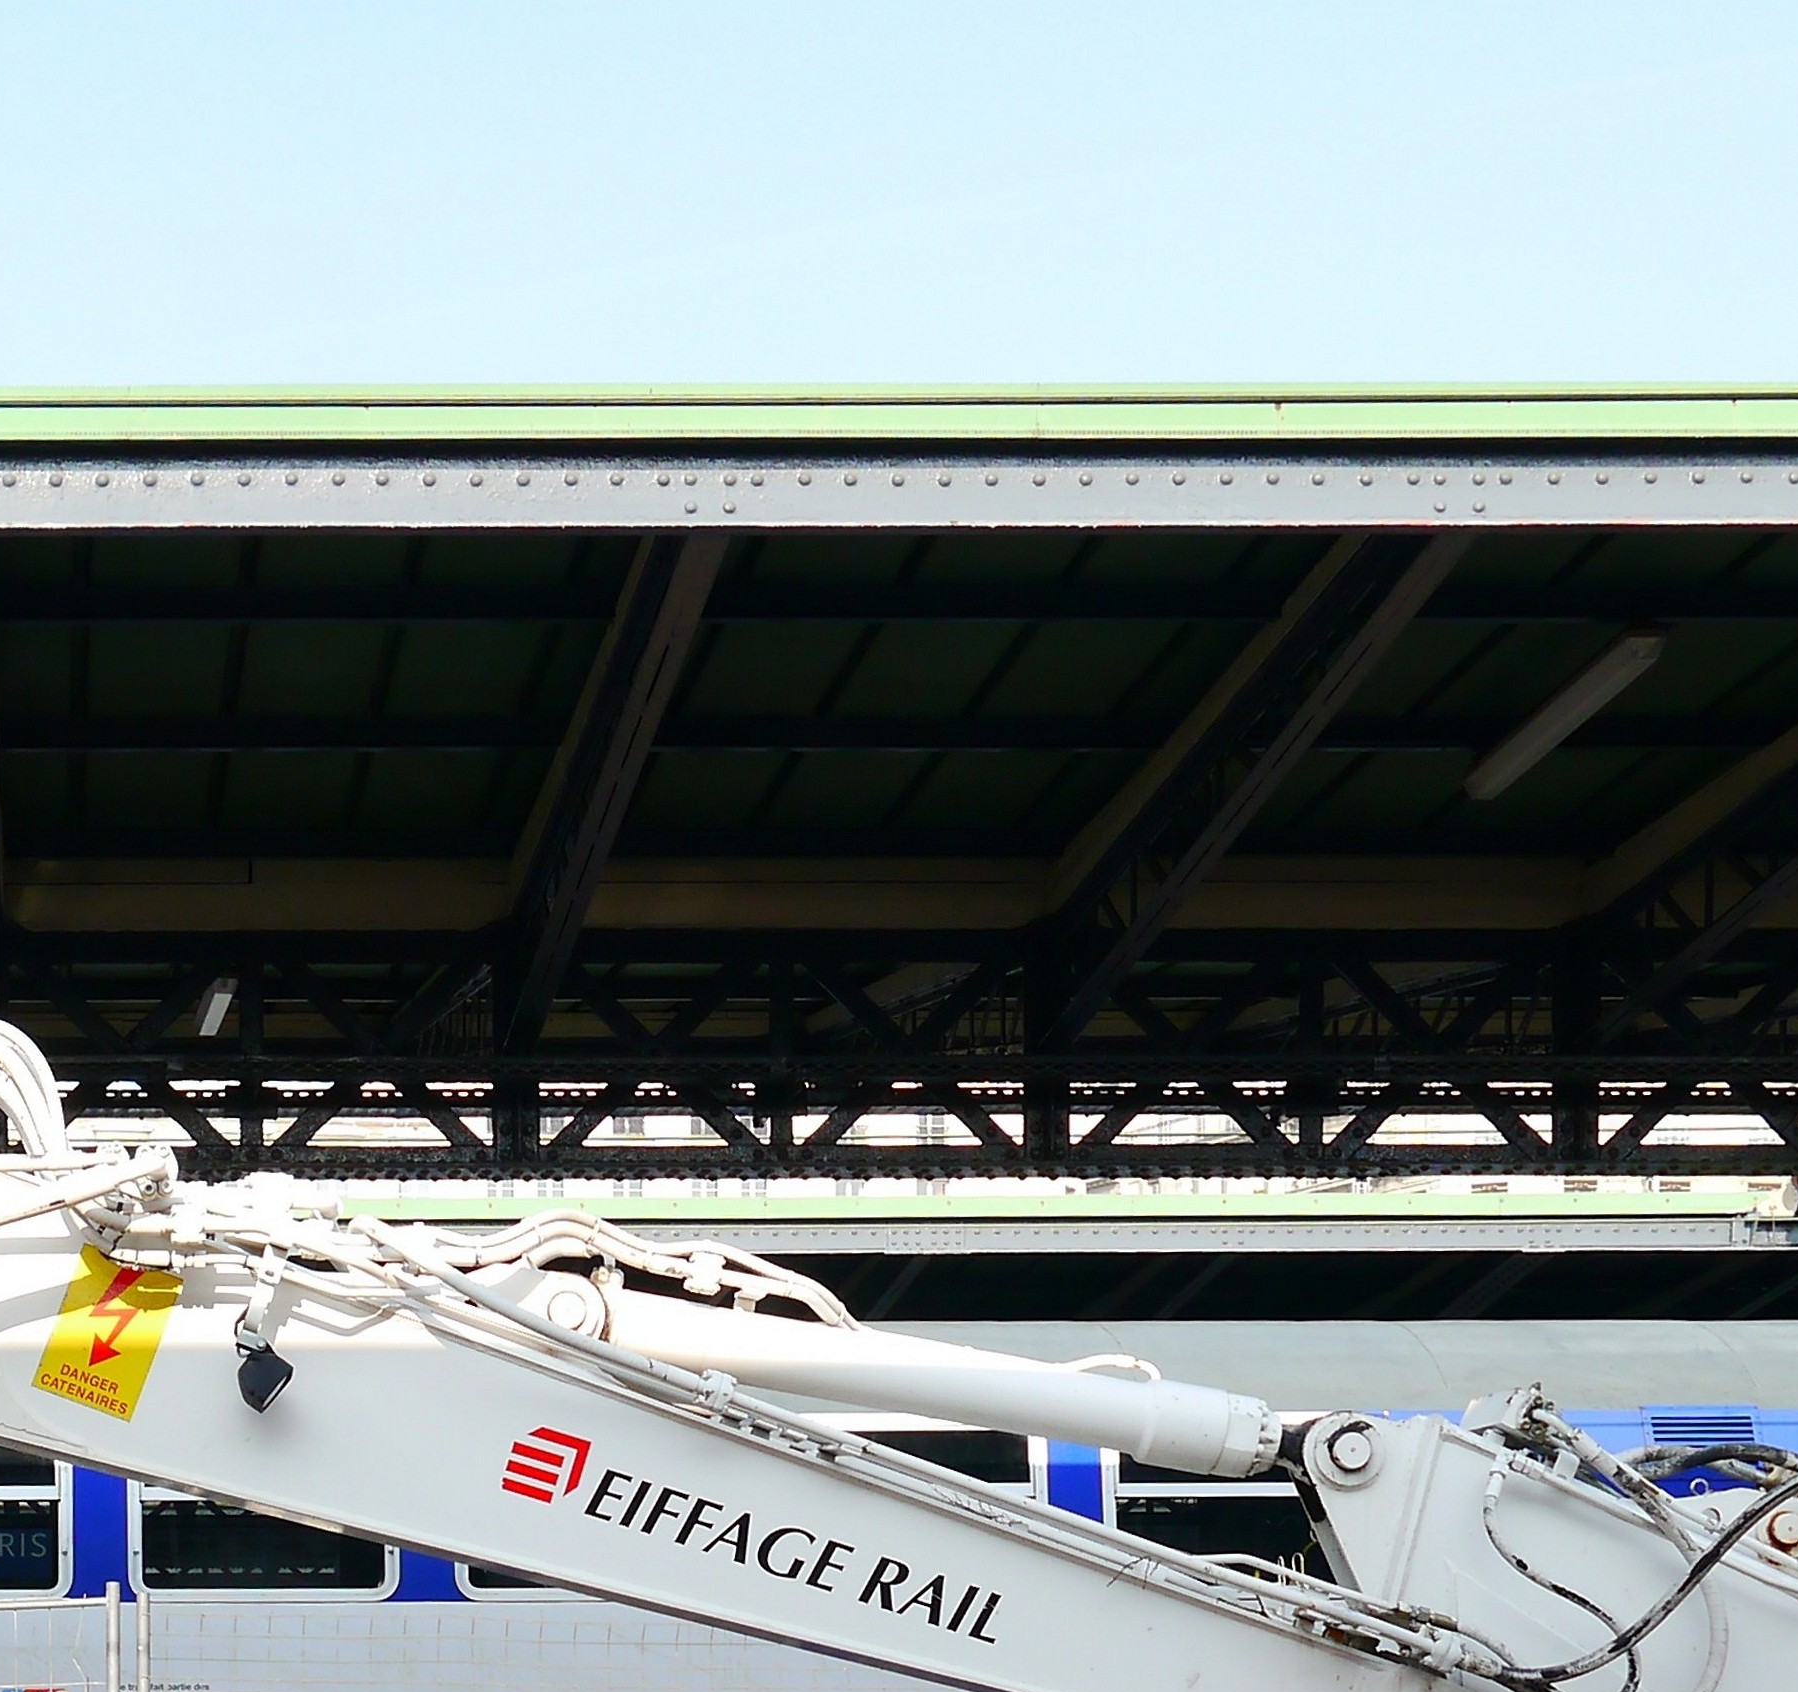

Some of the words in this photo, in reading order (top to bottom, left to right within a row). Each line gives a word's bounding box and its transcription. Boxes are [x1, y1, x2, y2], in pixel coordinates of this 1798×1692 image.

[40, 1373, 129, 1415] CATENAIRES
[59, 1364, 119, 1395] DANGER
[584, 1468, 856, 1593] EIFFAGE
[857, 1556, 1003, 1645] RAIL
